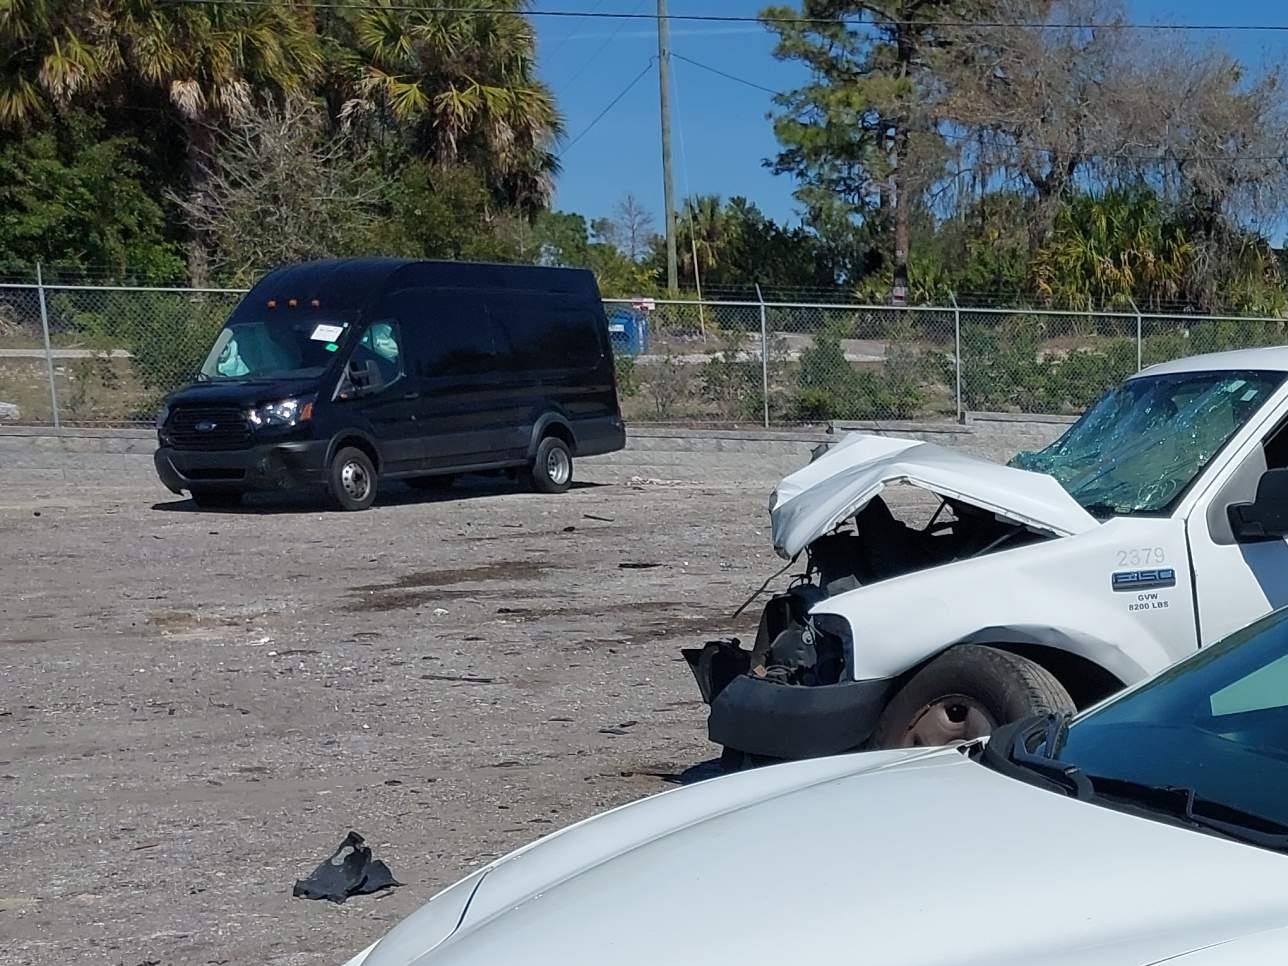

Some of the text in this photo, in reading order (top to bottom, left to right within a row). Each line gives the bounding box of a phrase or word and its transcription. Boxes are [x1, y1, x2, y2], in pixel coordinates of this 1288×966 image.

[1117, 547, 1165, 566] 2379
[1137, 593, 1159, 602] GVW
[1128, 601, 1169, 611] 8200 LBS
